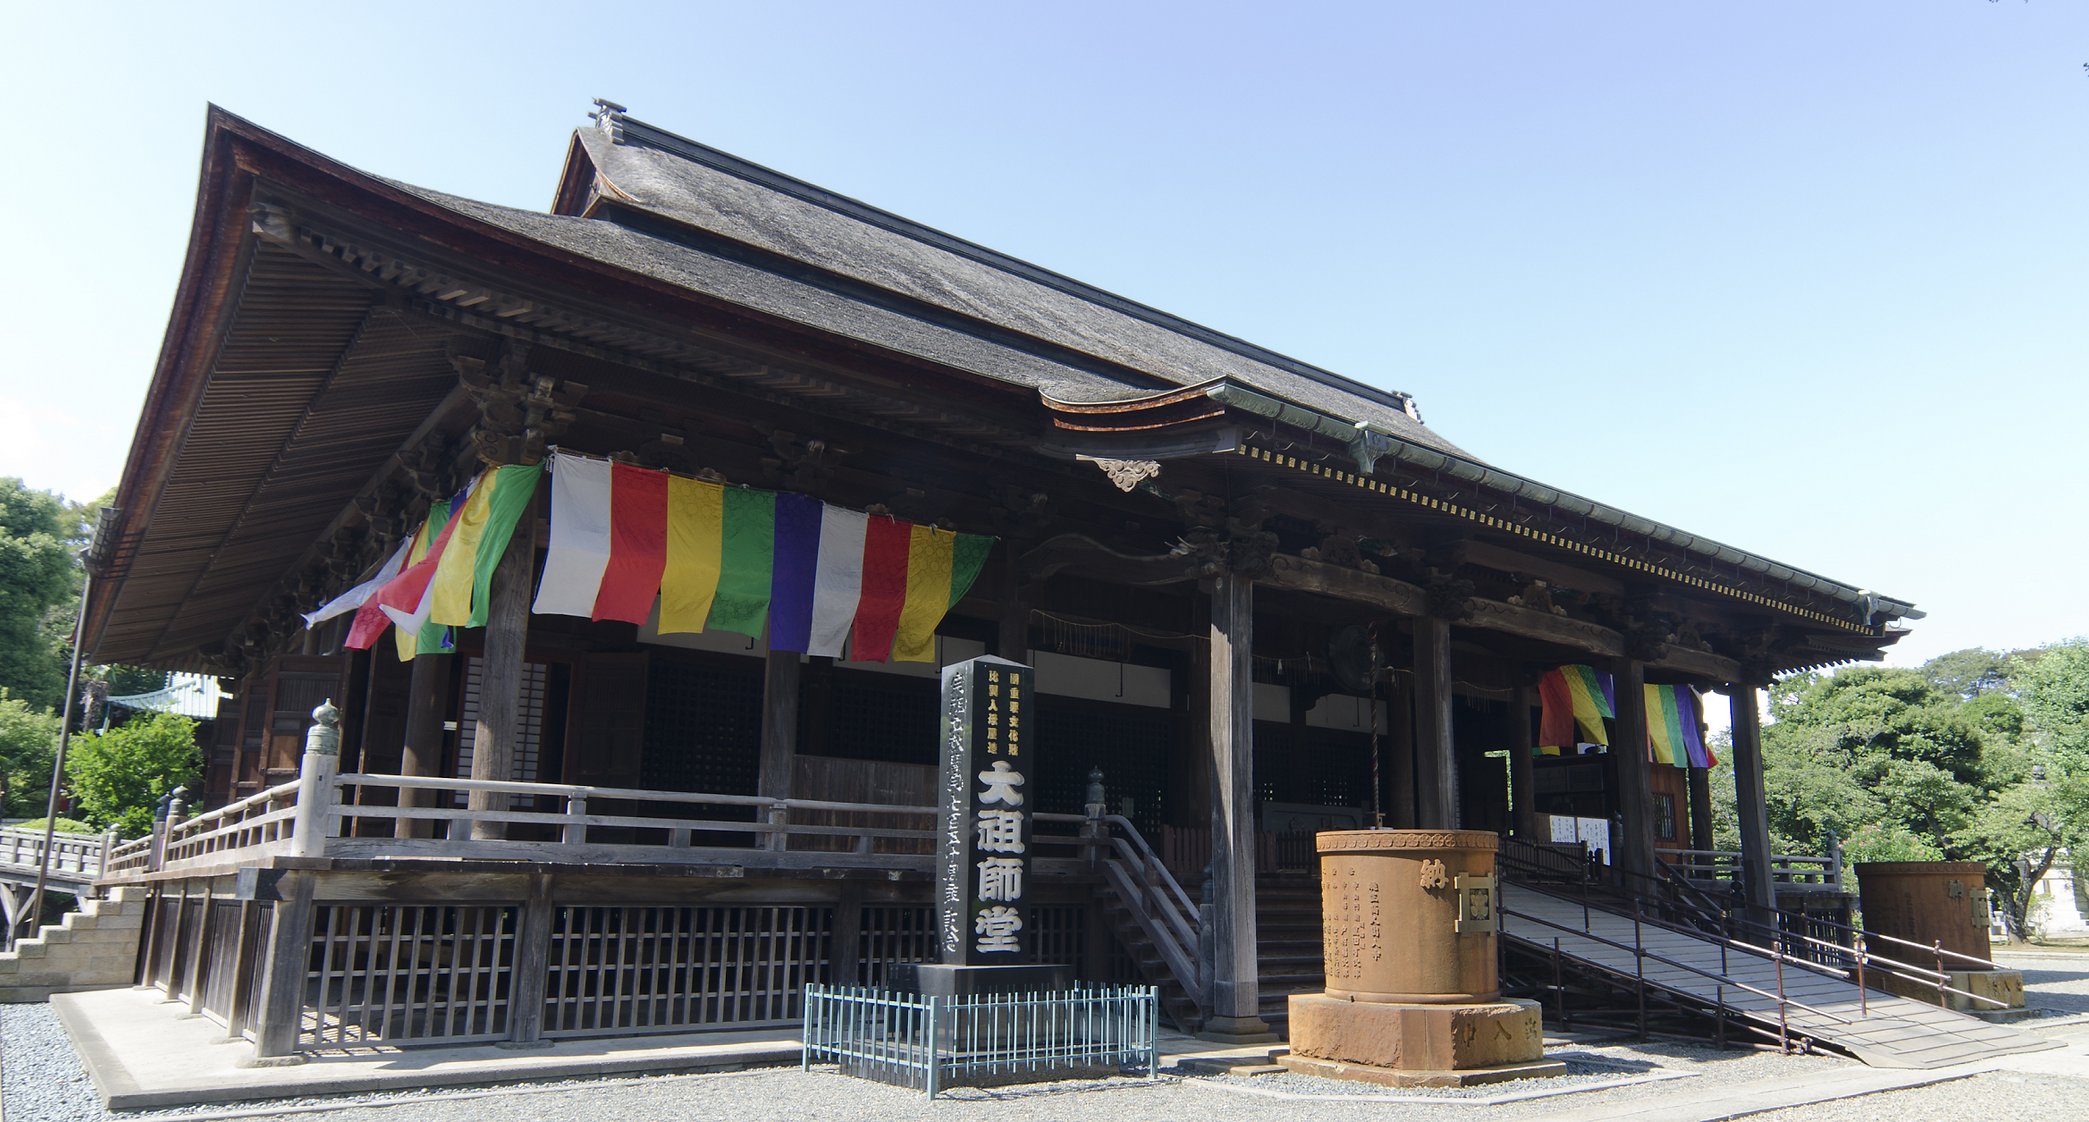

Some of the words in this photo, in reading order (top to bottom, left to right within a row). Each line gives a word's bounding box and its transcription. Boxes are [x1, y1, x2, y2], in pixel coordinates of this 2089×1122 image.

[975, 760, 1025, 953] 大祖師堂
[1420, 858, 1449, 889] 納
